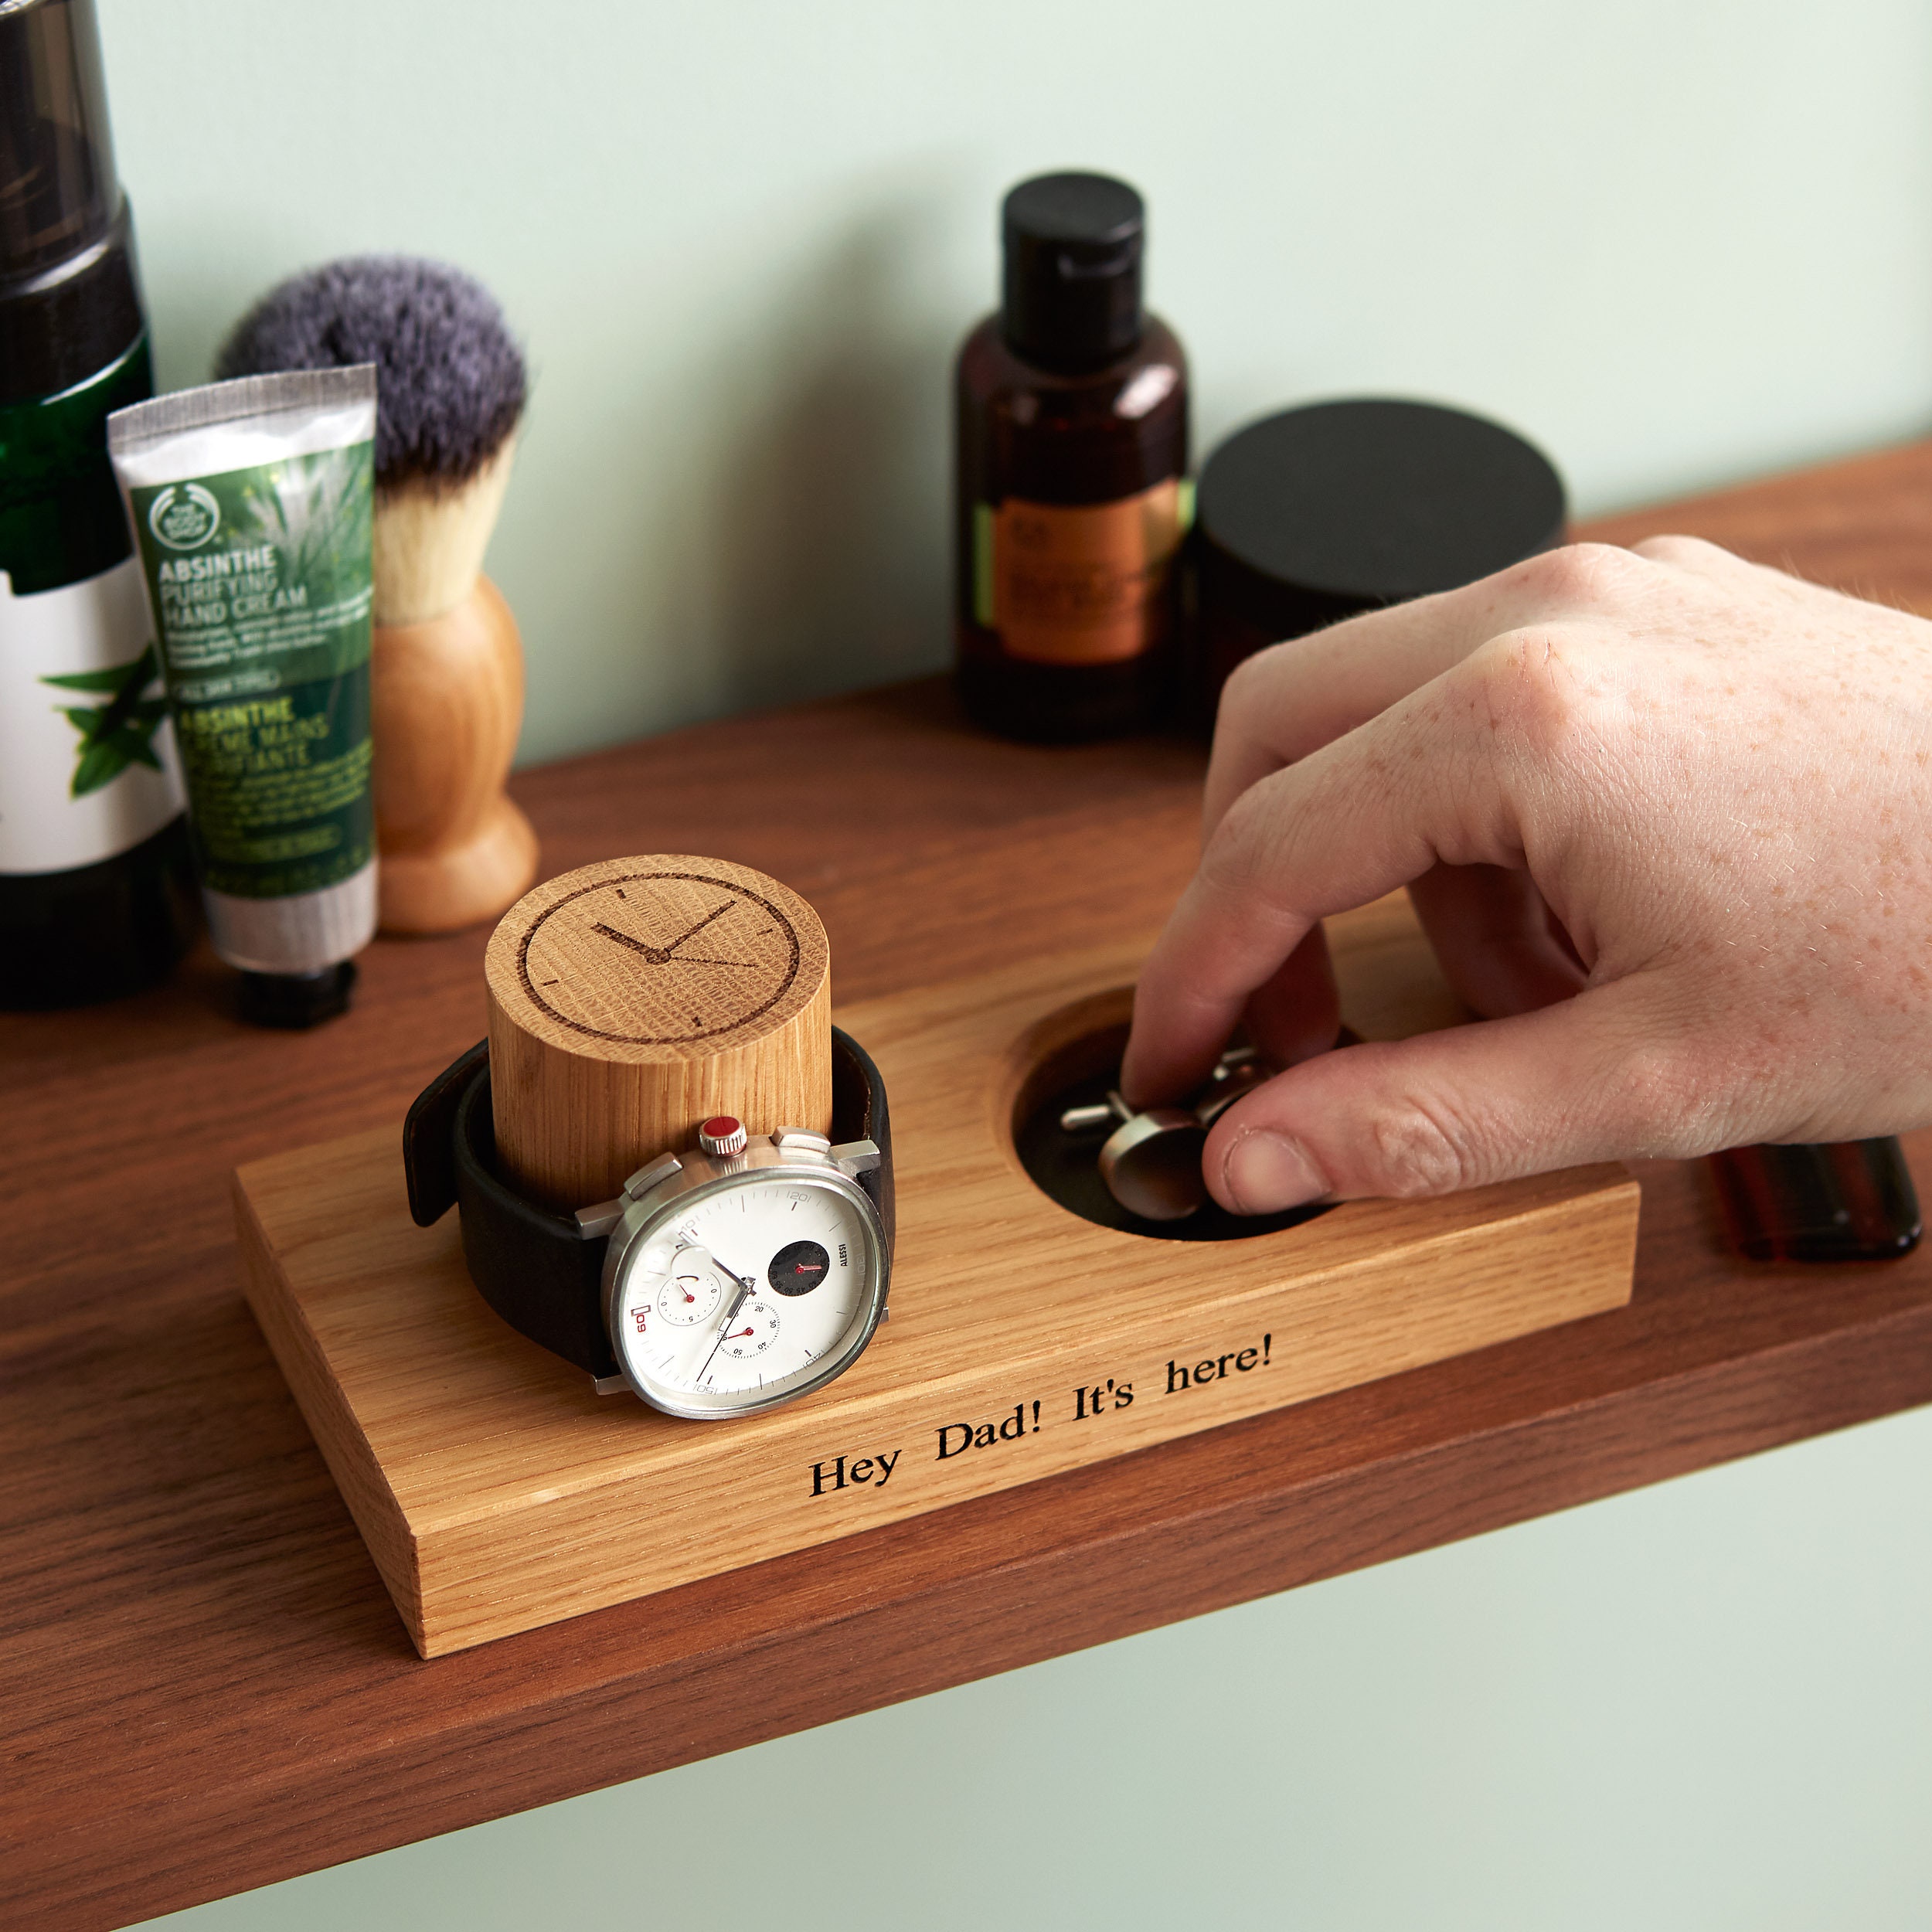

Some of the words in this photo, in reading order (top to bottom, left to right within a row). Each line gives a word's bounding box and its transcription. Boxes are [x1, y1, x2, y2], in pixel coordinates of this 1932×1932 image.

[159, 545, 277, 583] ABSINTHE
[161, 571, 279, 607] PURIFYING
[163, 600, 227, 629] HAND
[233, 585, 308, 620] CREAM
[181, 696, 294, 734] ABSINTHE
[838, 1243, 848, 1267] ALESSI
[636, 1315, 646, 1333] 60
[769, 1319, 777, 1328] 30
[808, 1449, 903, 1498] Hey
[934, 1400, 1041, 1461] Dad!
[1072, 1379, 1134, 1422] It's
[1165, 1333, 1272, 1395] here!
